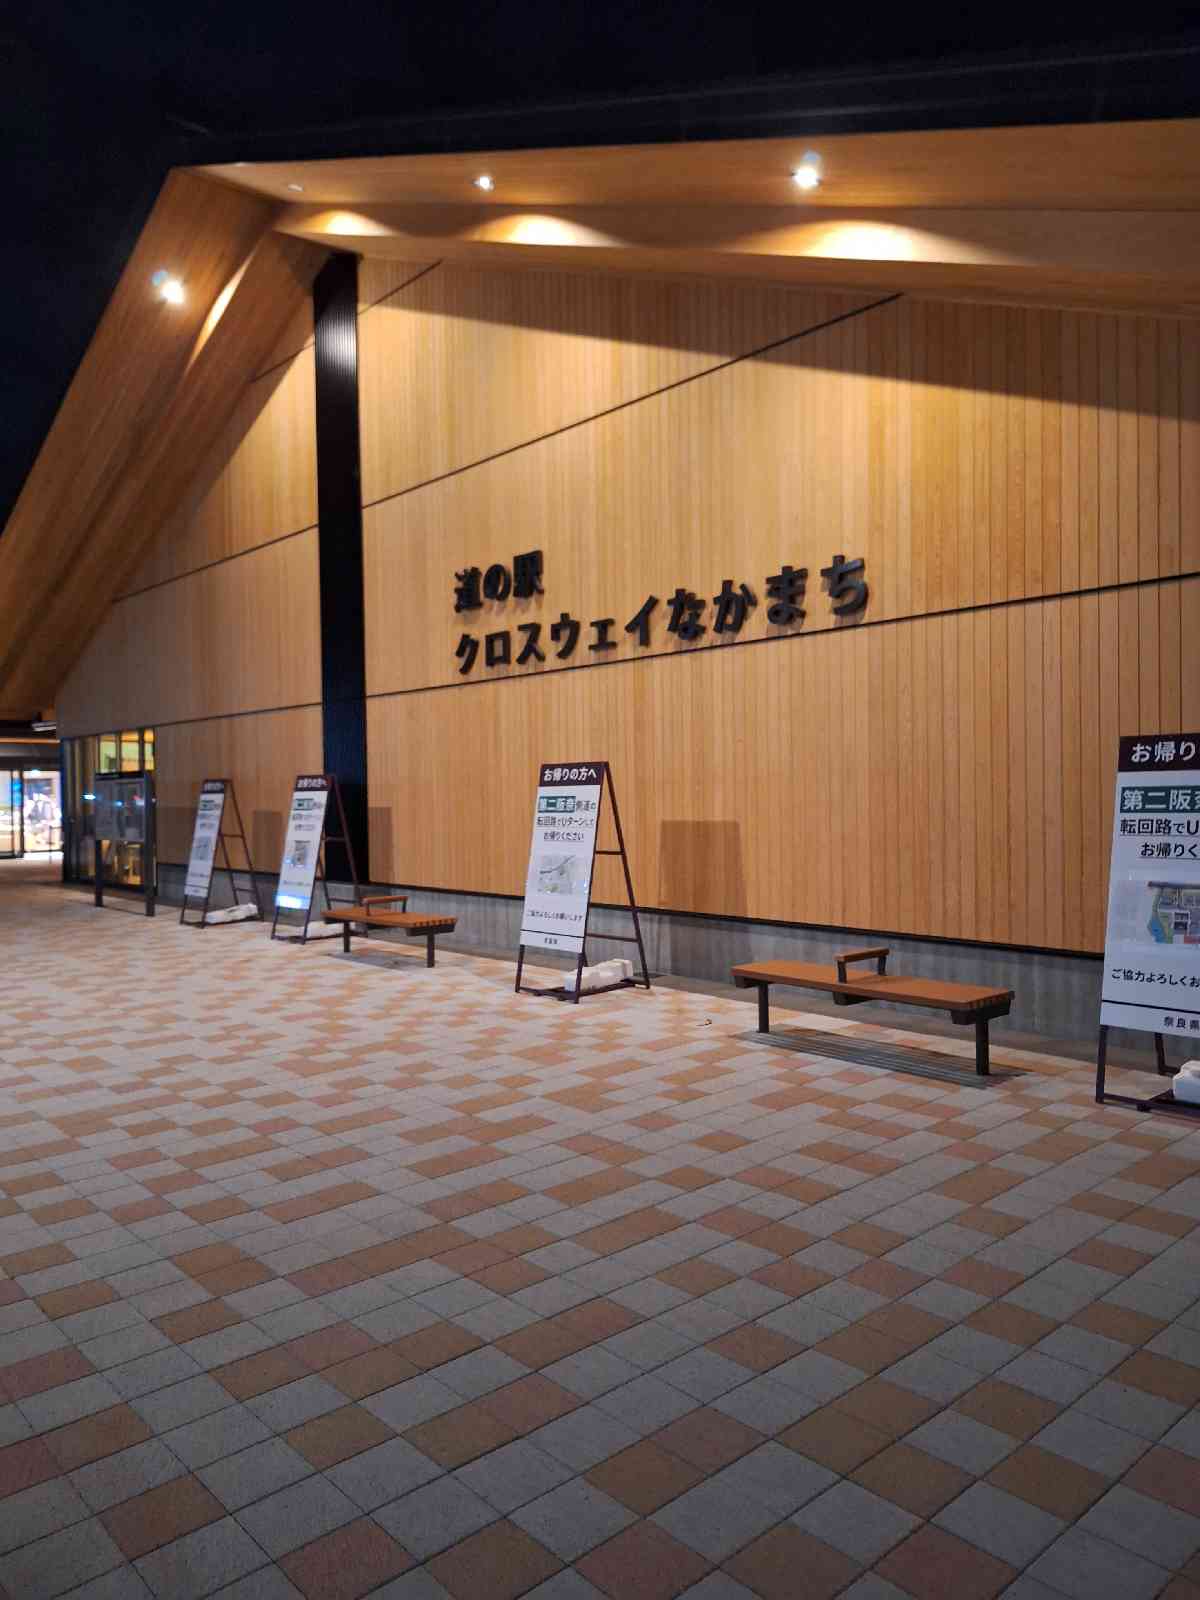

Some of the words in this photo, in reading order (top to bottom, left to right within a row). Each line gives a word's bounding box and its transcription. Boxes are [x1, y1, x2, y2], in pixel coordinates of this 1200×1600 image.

[454, 549, 544, 613] 道の駅
[455, 555, 869, 675] クロスウェイなかまち
[543, 766, 597, 782] お帰りの方へ
[1140, 842, 1199, 858] お帰りく
